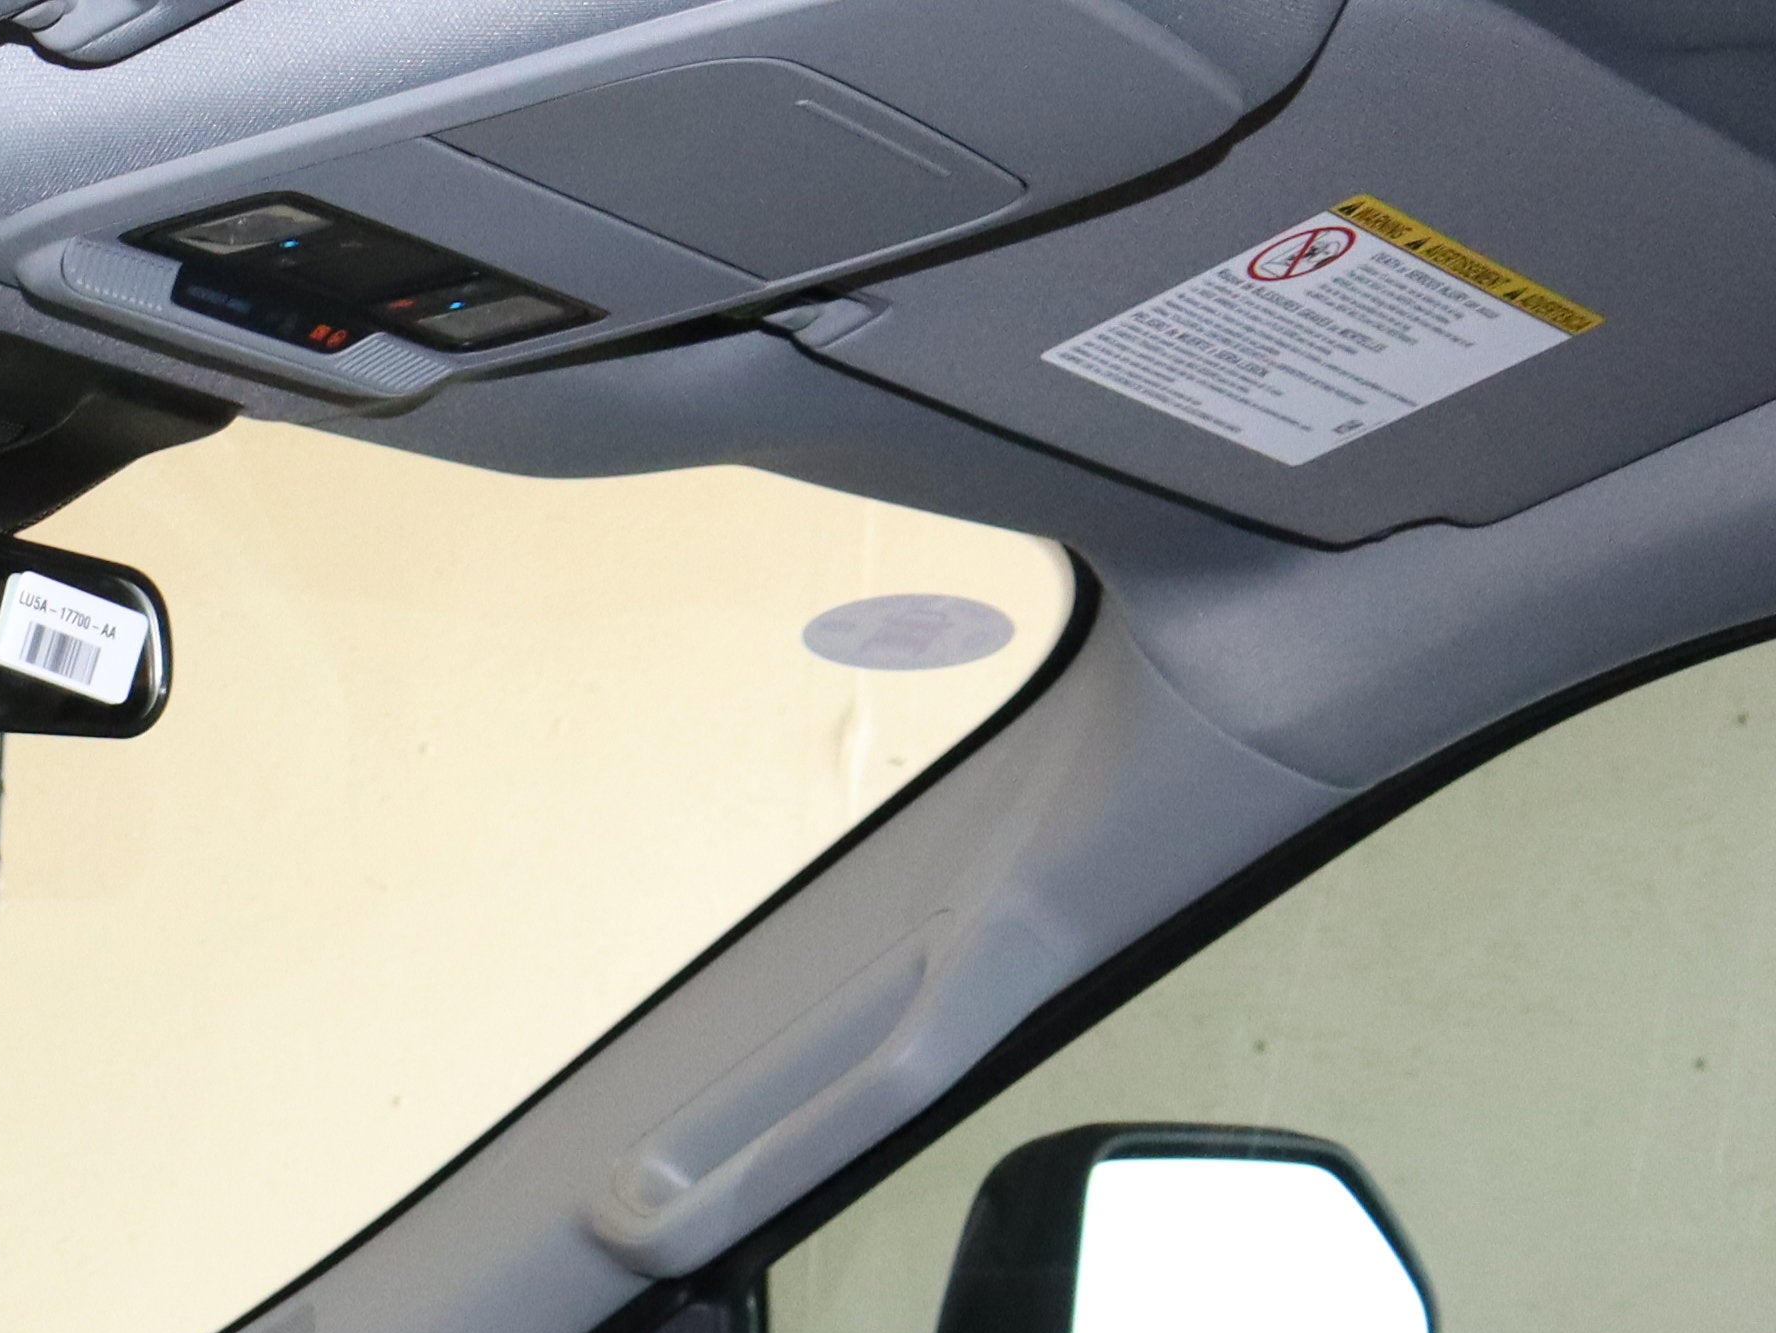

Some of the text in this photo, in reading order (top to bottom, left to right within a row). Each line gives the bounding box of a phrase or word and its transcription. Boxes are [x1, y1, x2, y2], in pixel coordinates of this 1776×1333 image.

[19, 590, 48, 613] LU5A
[61, 607, 91, 630] 17700
[101, 623, 116, 640] AA
